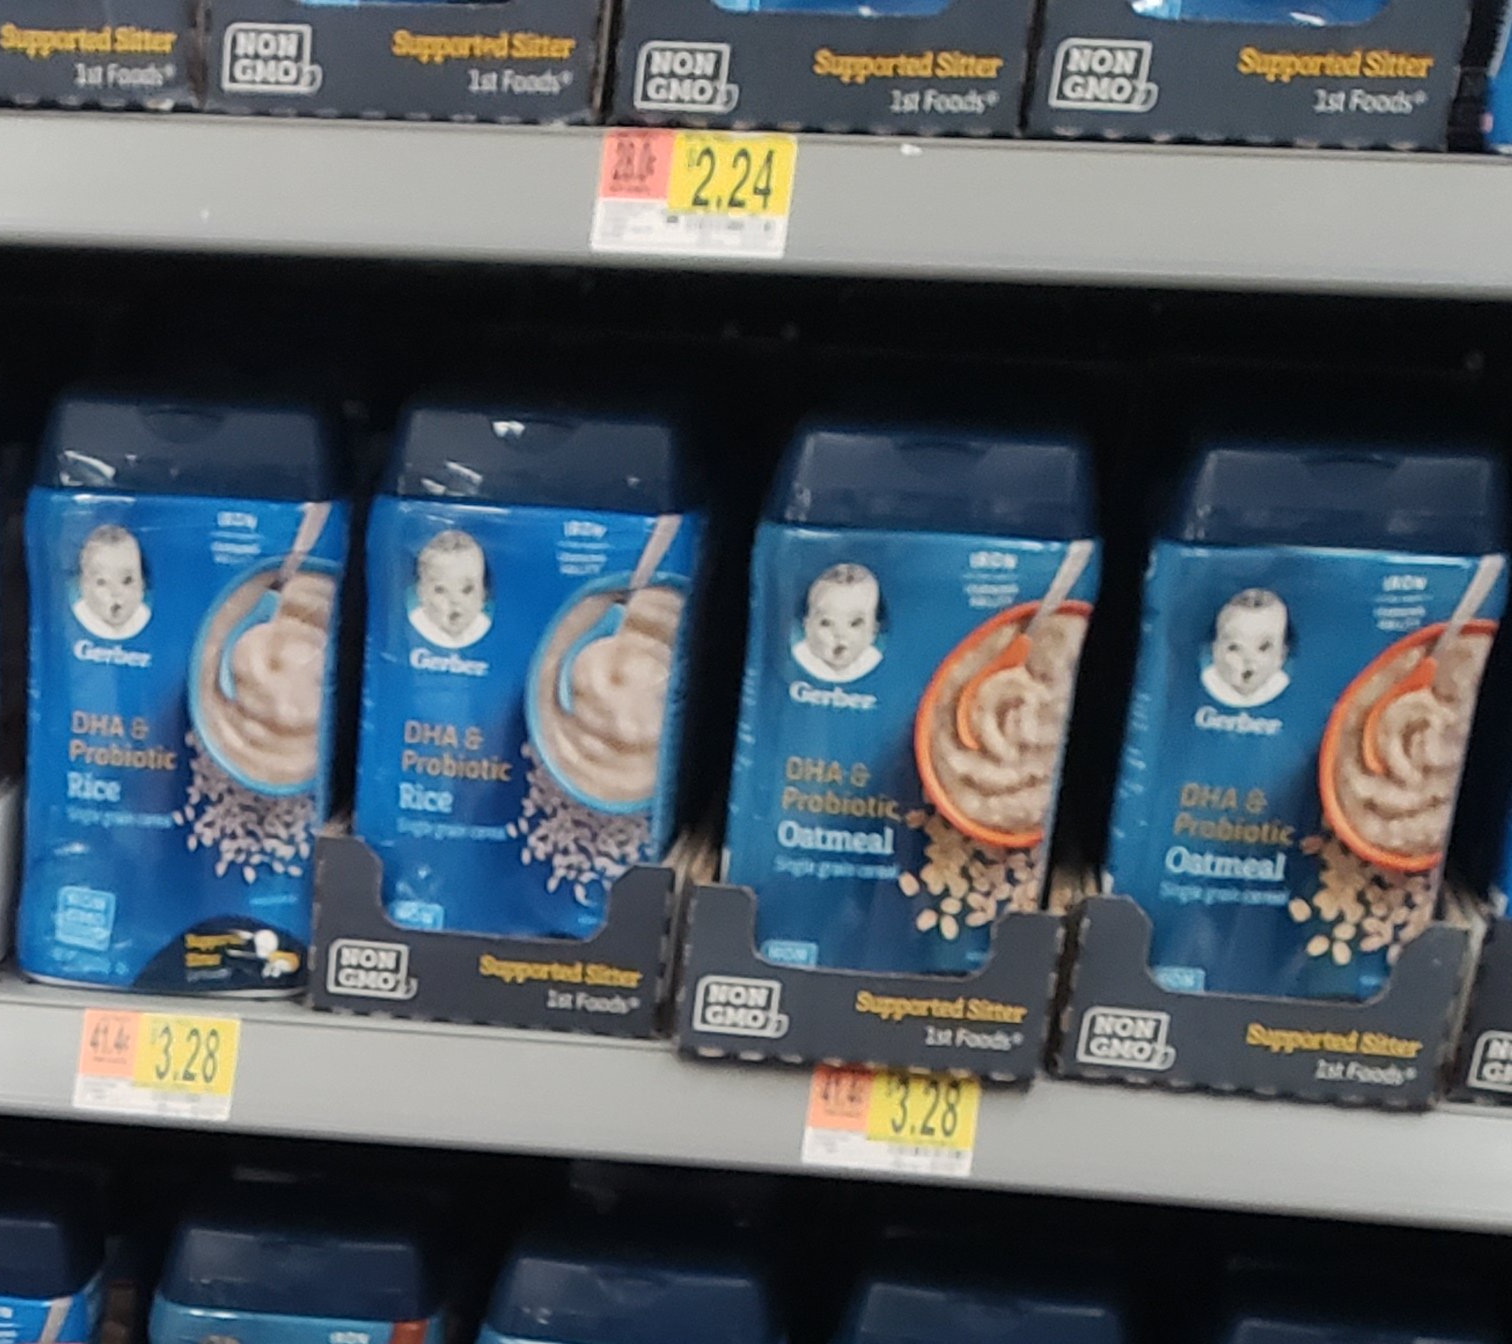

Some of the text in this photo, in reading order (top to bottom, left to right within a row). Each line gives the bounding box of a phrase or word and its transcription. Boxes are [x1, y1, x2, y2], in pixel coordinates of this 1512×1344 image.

[235, 32, 298, 60] NON
[391, 31, 576, 64] Supported Sitter
[1066, 48, 1136, 74] NON
[232, 58, 300, 84] GMO
[650, 49, 716, 77] NON
[814, 49, 1003, 82] Supported Sitter
[1238, 48, 1433, 82] Supported Sitter
[647, 76, 718, 103] GMO
[1063, 74, 1135, 101] GMO
[409, 646, 488, 678] Gerber
[789, 680, 877, 711] Gerber
[70, 711, 125, 739] DHA
[404, 720, 484, 751] DHA &
[1195, 704, 1282, 736] Gerber
[70, 742, 177, 772] Probiotic
[401, 748, 511, 782] Probiotic
[785, 756, 844, 784] DHA
[67, 771, 121, 802] Rice
[399, 782, 454, 814] Rice
[1179, 782, 1240, 812] DHA
[782, 788, 900, 821] Probiotic
[776, 820, 895, 855] Oatmeal
[1172, 811, 1294, 848] Probiotic
[1164, 845, 1286, 880] Oatmeal
[340, 948, 396, 971] NON
[479, 954, 642, 989] Supported Sitter
[338, 968, 396, 992] GMO
[707, 985, 767, 1009] NON
[855, 991, 1028, 1024] Supported Sitter
[705, 1006, 765, 1030] GMO
[1092, 1014, 1157, 1039] NON
[1089, 1036, 1154, 1061] GMO
[1246, 1022, 1423, 1060] Supported Sitter
